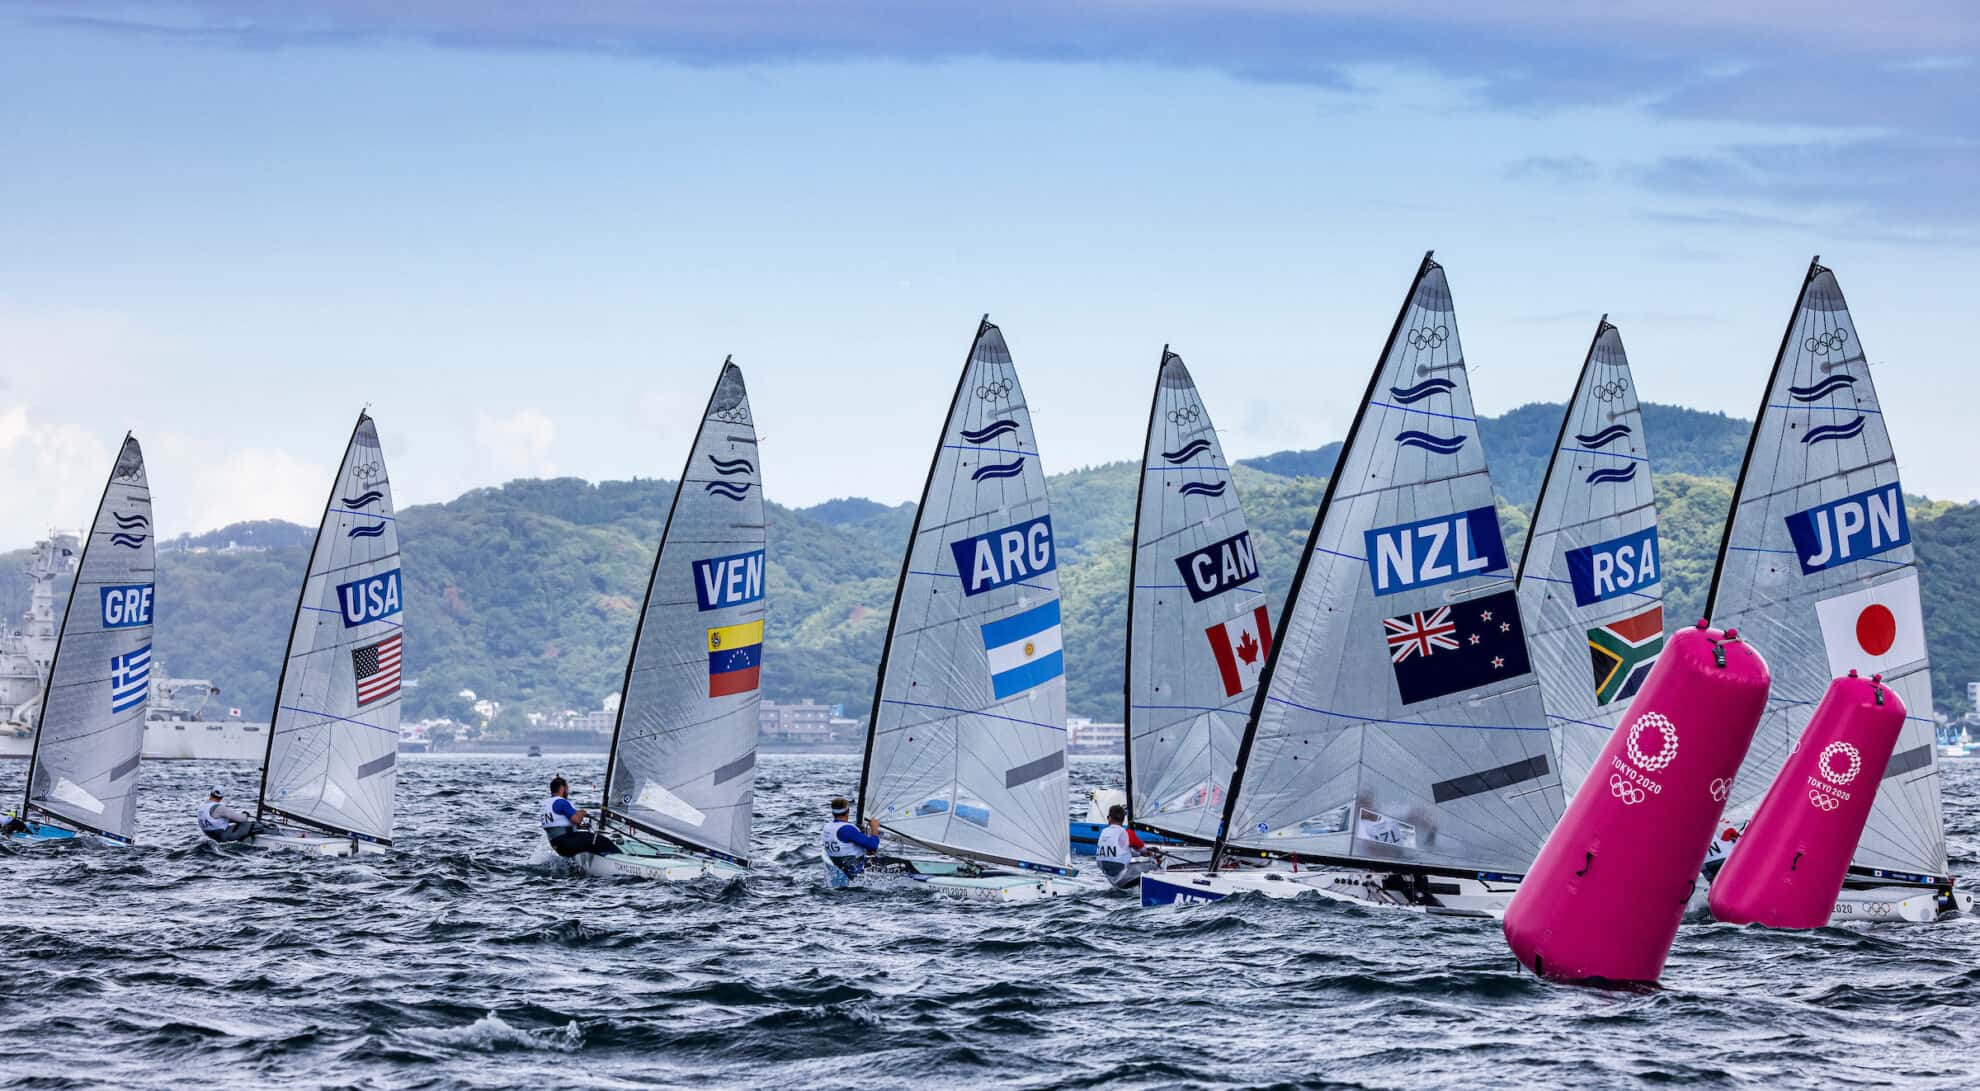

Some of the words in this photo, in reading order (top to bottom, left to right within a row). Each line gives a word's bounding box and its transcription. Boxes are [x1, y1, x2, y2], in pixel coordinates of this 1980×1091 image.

[1806, 488, 1900, 567] JPN
[971, 522, 1050, 591] ARG
[1191, 535, 1256, 592] CAN
[1376, 518, 1489, 590] NZL
[1592, 538, 1655, 596] RSA
[345, 574, 399, 622] USA
[701, 554, 764, 606] VEN
[105, 587, 153, 624] GRE
[1611, 755, 1637, 780] TOKYO
[1636, 774, 1662, 794] 2020
[1807, 776, 1832, 793] TOKYO
[1831, 787, 1850, 801] 2020
[824, 841, 840, 853] RG
[1096, 845, 1117, 857] AN
